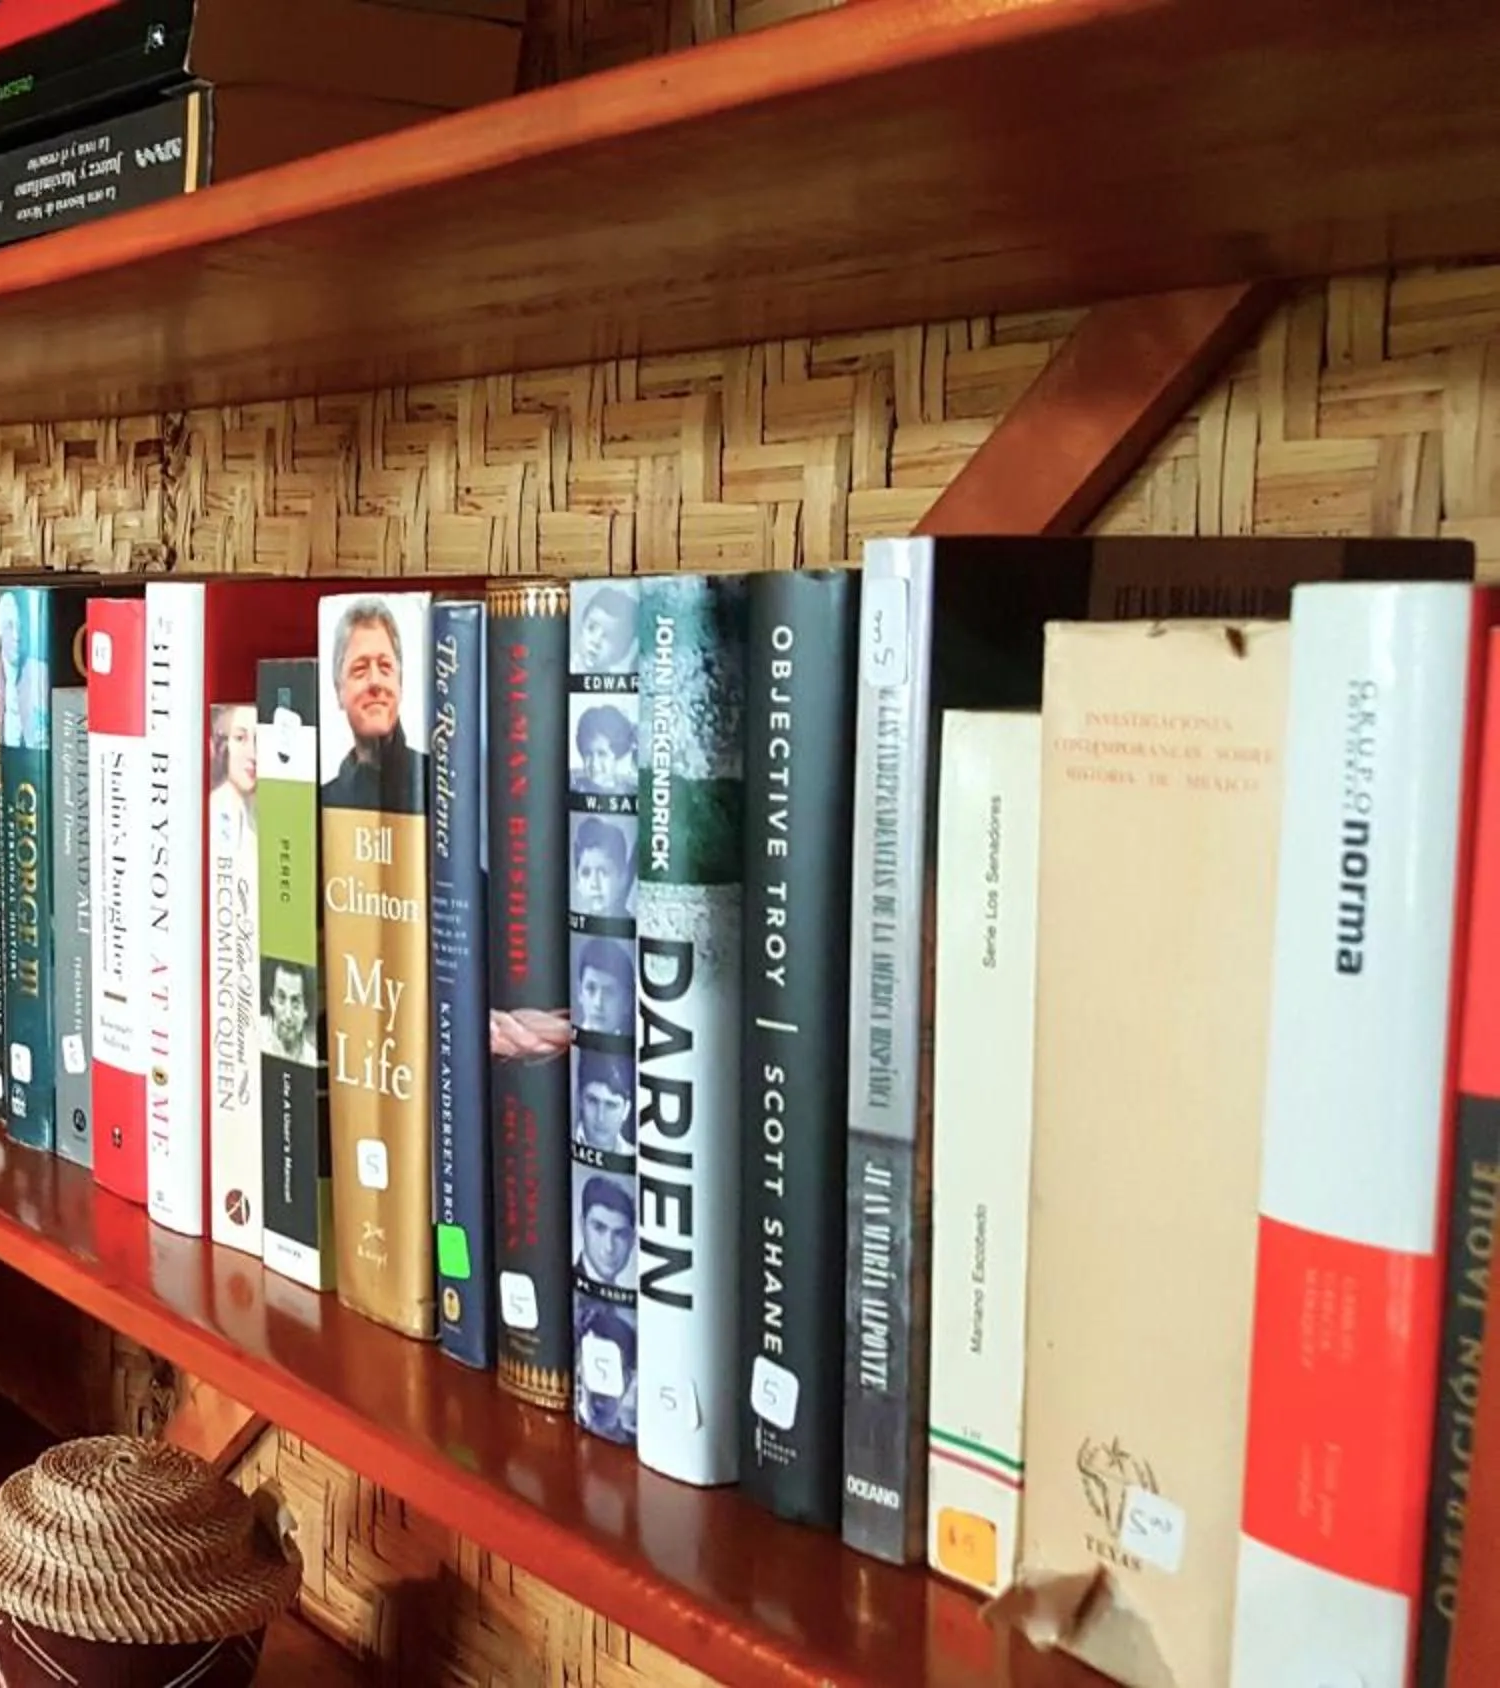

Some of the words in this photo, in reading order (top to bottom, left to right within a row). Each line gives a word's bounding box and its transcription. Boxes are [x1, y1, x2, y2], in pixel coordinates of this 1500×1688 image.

[435, 633, 459, 696] The
[583, 675, 640, 691] EDWAR
[653, 614, 675, 686] JOHN
[508, 643, 529, 800] SALMAN
[766, 625, 794, 859] OBJECTIVE
[1354, 679, 1379, 816] GRUPO
[76, 713, 91, 888] MUHAMMAD
[111, 752, 127, 846] Stalin's
[431, 701, 458, 859] Residence
[609, 796, 640, 812] SAI
[651, 689, 674, 872] McKENDRICK
[7, 819, 16, 904] PERSONAL
[16, 782, 38, 948] GEORGE
[151, 752, 170, 935] BRYSON
[278, 838, 292, 904] PEREC
[354, 826, 393, 865] Bill
[986, 795, 1003, 884] Senadores
[77, 891, 91, 934] ALI
[109, 855, 128, 982] Daughter
[215, 856, 234, 1009] BECOMING
[325, 875, 420, 922] Clinton
[508, 815, 528, 986] RUSHDIE
[870, 921, 897, 944] LA
[871, 895, 897, 918] DE
[984, 890, 999, 920] Los
[1336, 819, 1370, 976] norma
[9, 911, 17, 981] HISTORY
[764, 882, 788, 989] TROY
[982, 925, 998, 970] Serie
[18, 958, 40, 998] III
[150, 953, 170, 1012] AT
[342, 953, 405, 1032] My
[869, 952, 901, 1021] AMÉRICA
[235, 973, 254, 1065] Williams
[439, 1001, 452, 1052] KATE
[214, 1017, 235, 1112] QUEEN
[281, 1071, 291, 1099] Life
[334, 1030, 413, 1100] Life
[867, 1025, 899, 1110] HISPÁNICA
[283, 1112, 292, 1153] User's
[440, 1062, 454, 1176] ANDERSEN
[638, 936, 695, 1312] DARIEN
[763, 1064, 785, 1198] SCOTT
[283, 1155, 293, 1204] Manual
[571, 1144, 604, 1167] LACE
[864, 1160, 892, 1218] JUAN
[443, 1182, 455, 1224] BRO
[861, 1224, 897, 1291] MARÍA
[972, 1202, 988, 1285] Escobedo
[763, 1215, 784, 1355] SHANE
[859, 1300, 890, 1394] ALPONTE
[970, 1288, 984, 1356] Mariano
[846, 1474, 901, 1511] OCEANO
[1433, 1334, 1485, 1622] OPERACIÓN
[1084, 1531, 1143, 1574] TEXAS
